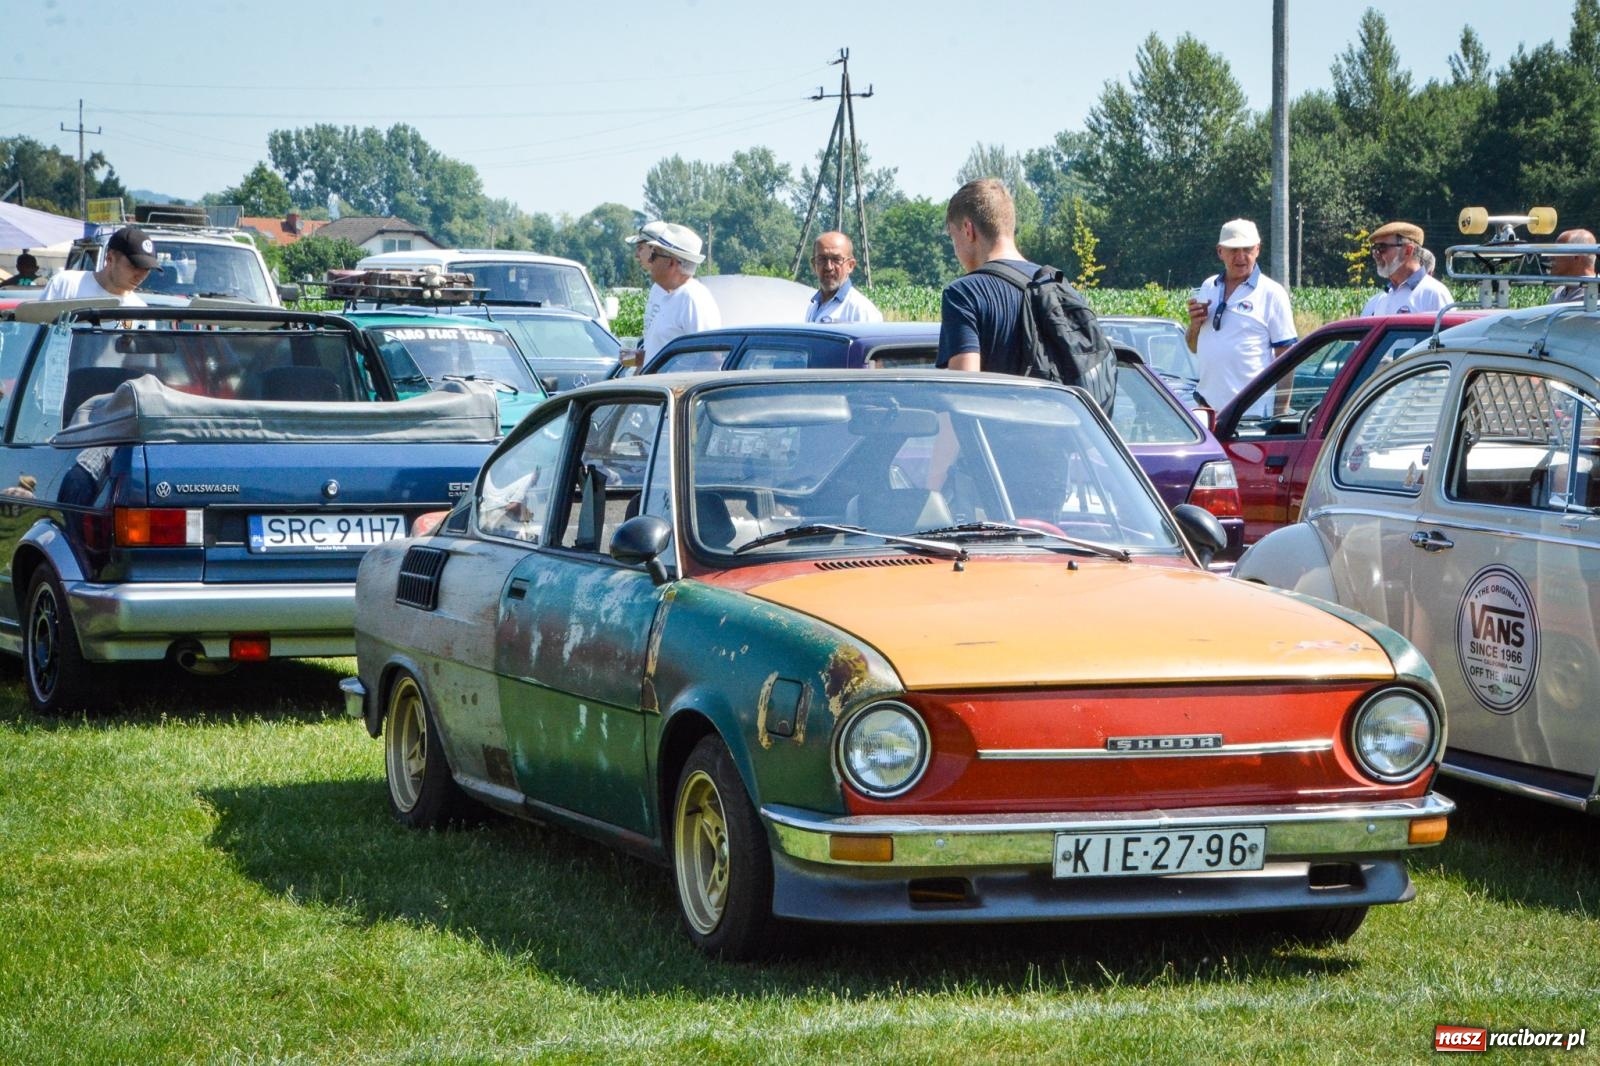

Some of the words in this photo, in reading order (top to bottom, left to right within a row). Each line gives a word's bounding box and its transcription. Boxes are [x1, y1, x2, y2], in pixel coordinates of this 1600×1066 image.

[427, 328, 458, 340] FIAT
[176, 484, 240, 494] VOLKSWAGEN
[267, 517, 328, 544] SRC
[336, 516, 401, 544] 91H7
[1478, 585, 1490, 598] THE
[1490, 584, 1519, 606] ORIGINAL
[1469, 601, 1526, 649] VANS
[1470, 640, 1499, 659] SINCE
[1500, 648, 1523, 665] 1966
[1469, 664, 1484, 678] OFF
[1485, 668, 1500, 682] THE
[1501, 673, 1523, 687] WALL
